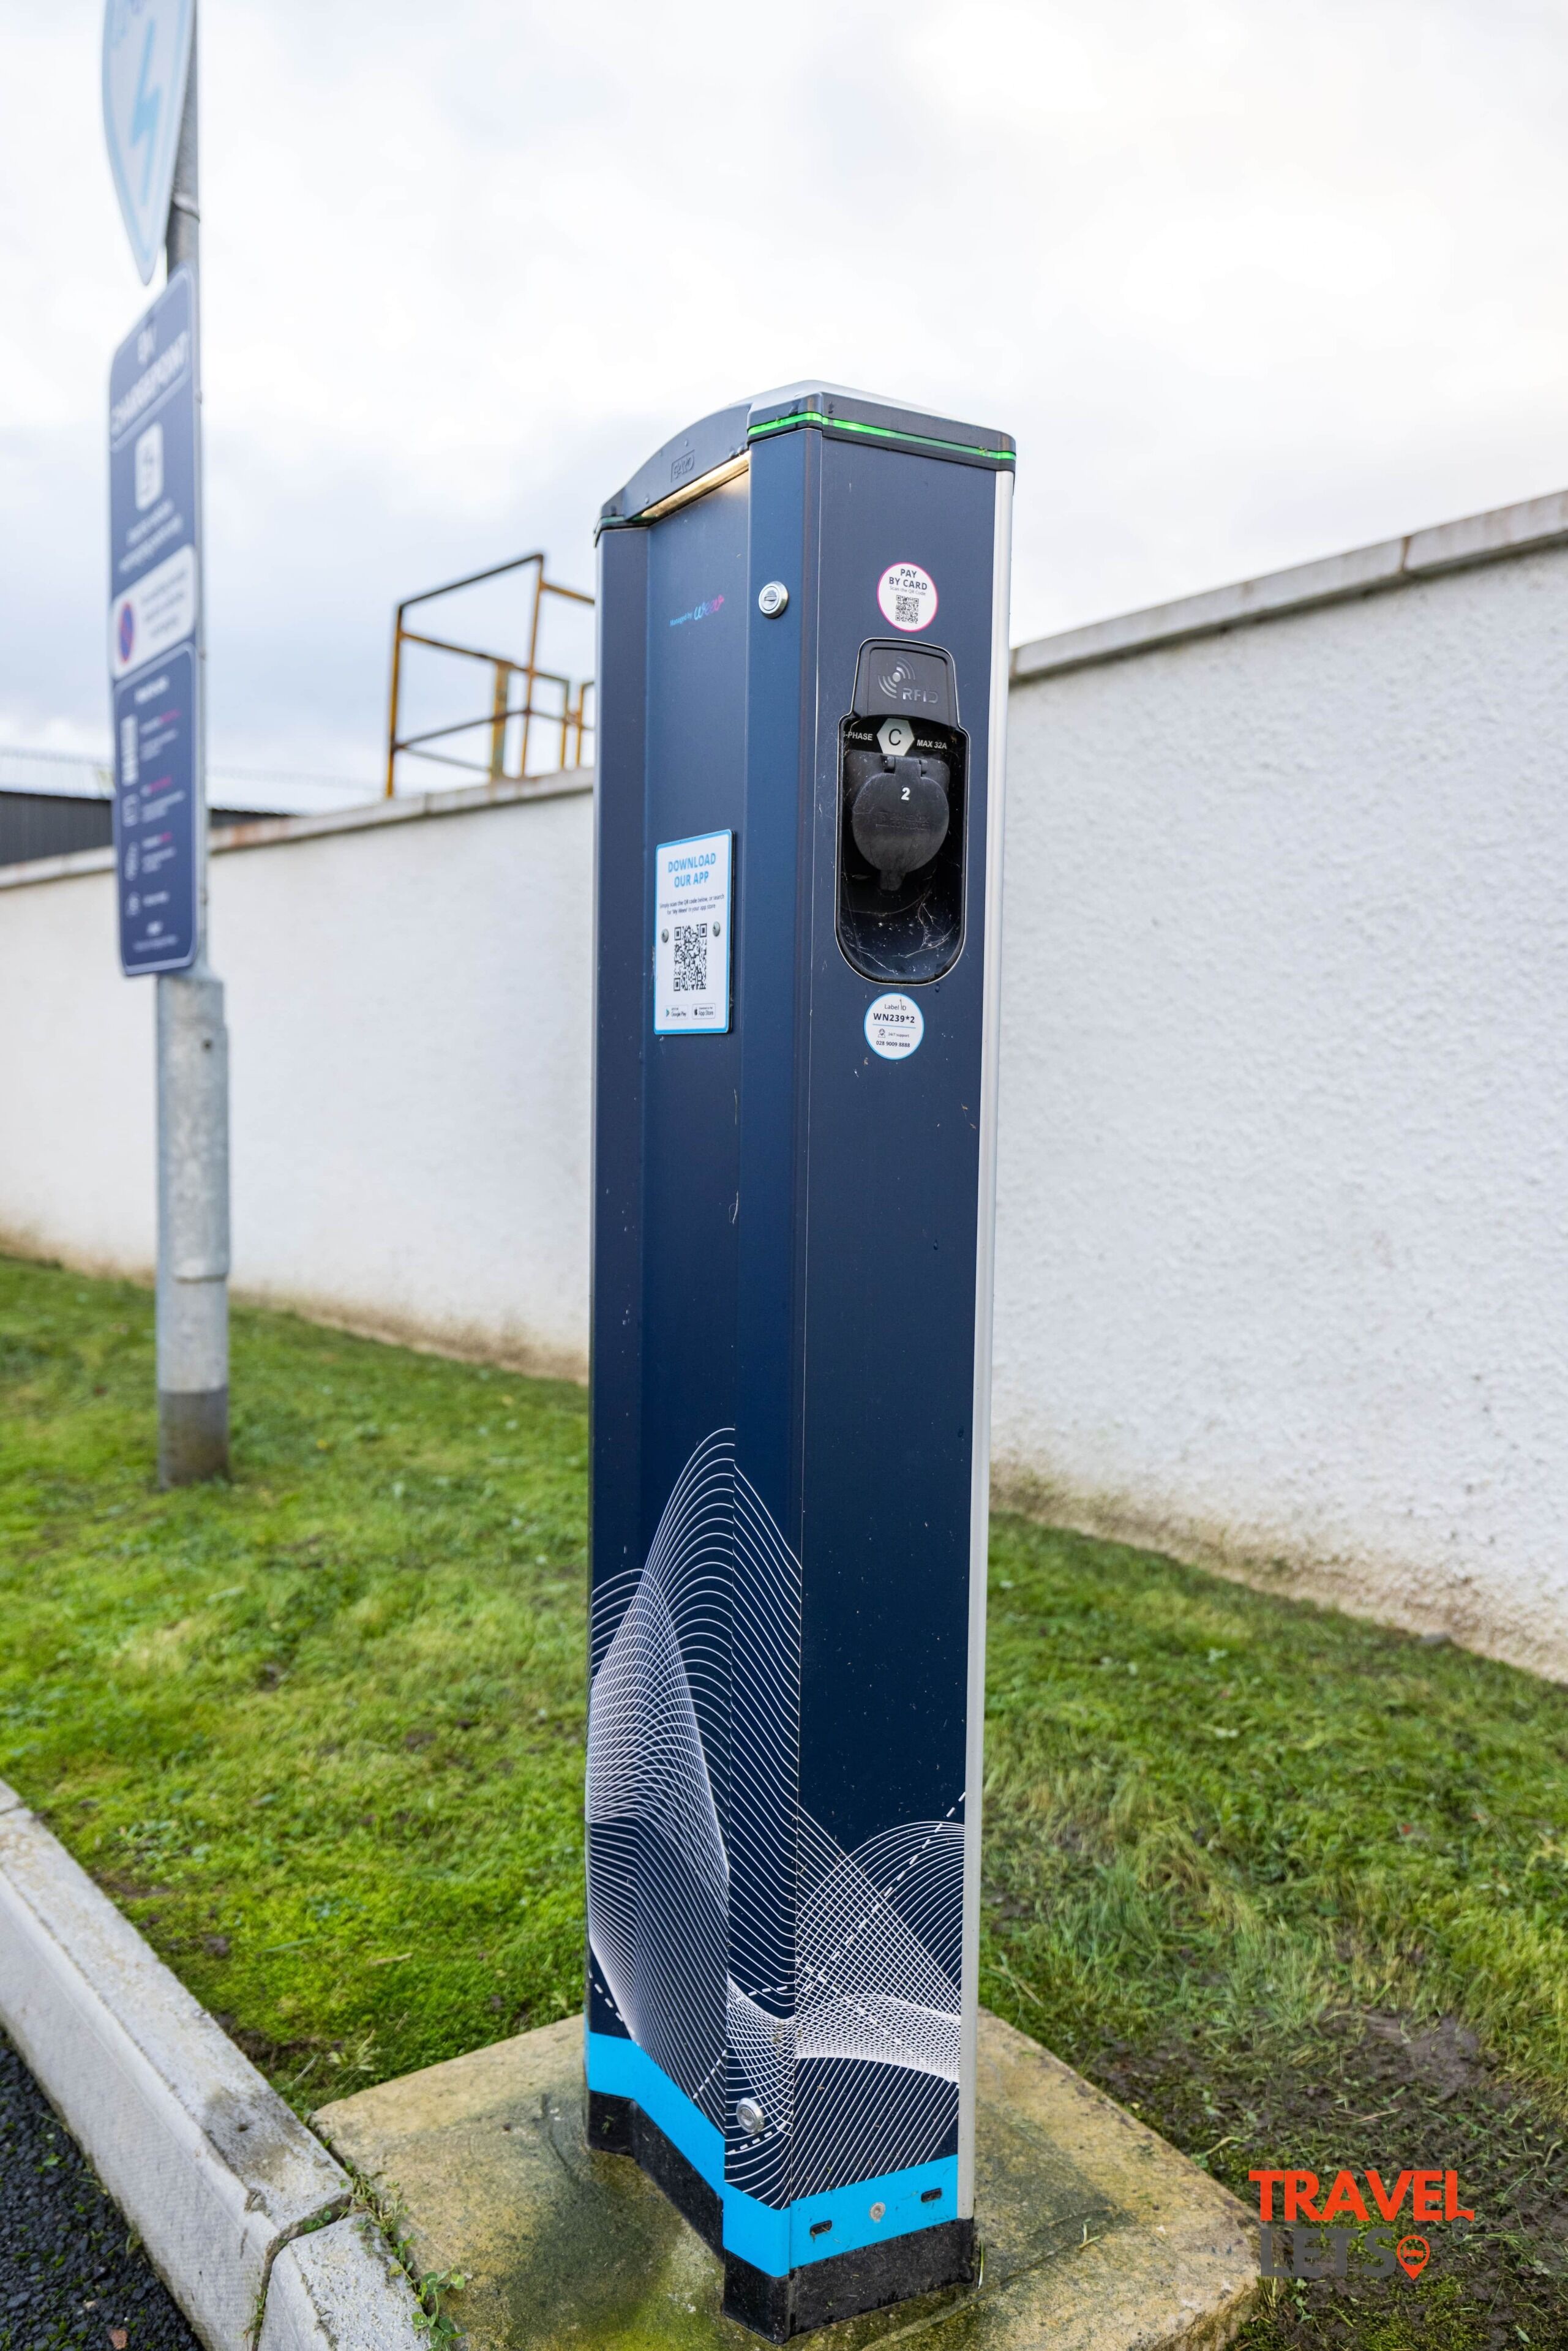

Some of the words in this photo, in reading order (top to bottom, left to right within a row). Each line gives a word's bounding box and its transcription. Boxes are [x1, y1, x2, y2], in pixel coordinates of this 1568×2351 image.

[900, 568, 917, 578] PAY
[889, 577, 900, 585] BY
[903, 579, 928, 590] CARD
[902, 688, 939, 703] RFID
[888, 729, 902, 746] C
[917, 739, 933, 748] MAX
[934, 741, 947, 749] 32A
[901, 787, 911, 801] 2
[668, 853, 716, 873] DOWNLOAD
[674, 874, 691, 888] OUR
[692, 871, 709, 885] APP
